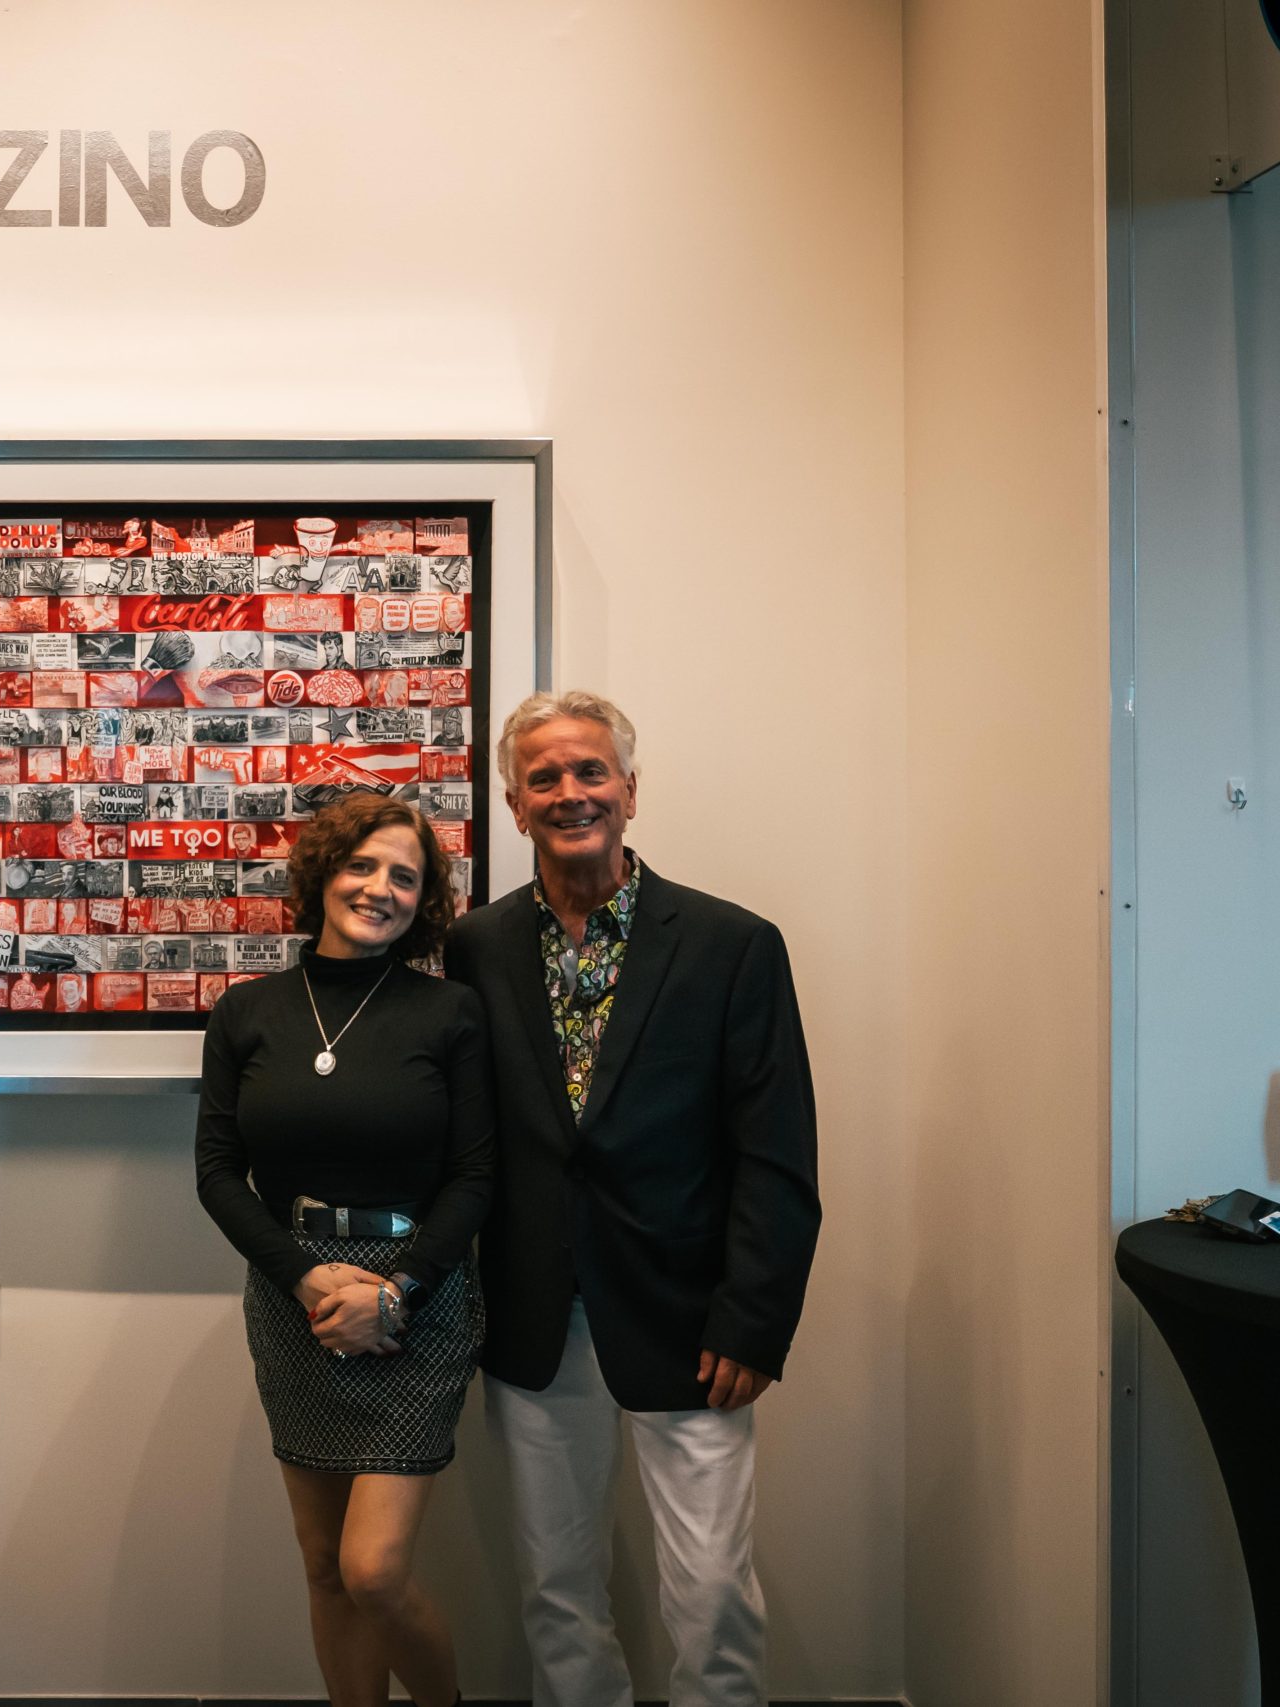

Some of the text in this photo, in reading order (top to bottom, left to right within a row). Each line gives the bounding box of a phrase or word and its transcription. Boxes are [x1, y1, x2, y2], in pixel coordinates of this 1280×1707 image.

[82, 537, 111, 556] Sea
[153, 552, 168, 561] THE
[171, 552, 204, 561] BOSTON
[15, 643, 29, 654] WAR
[401, 654, 463, 665] PHILIP MORRIS
[272, 680, 302, 701] Tide
[144, 760, 170, 768] MORE
[100, 786, 143, 799] OUR BLOOD
[100, 801, 144, 814] YOUR HANDS
[130, 828, 221, 852] ME TOO
[241, 952, 267, 960] DECLARE
